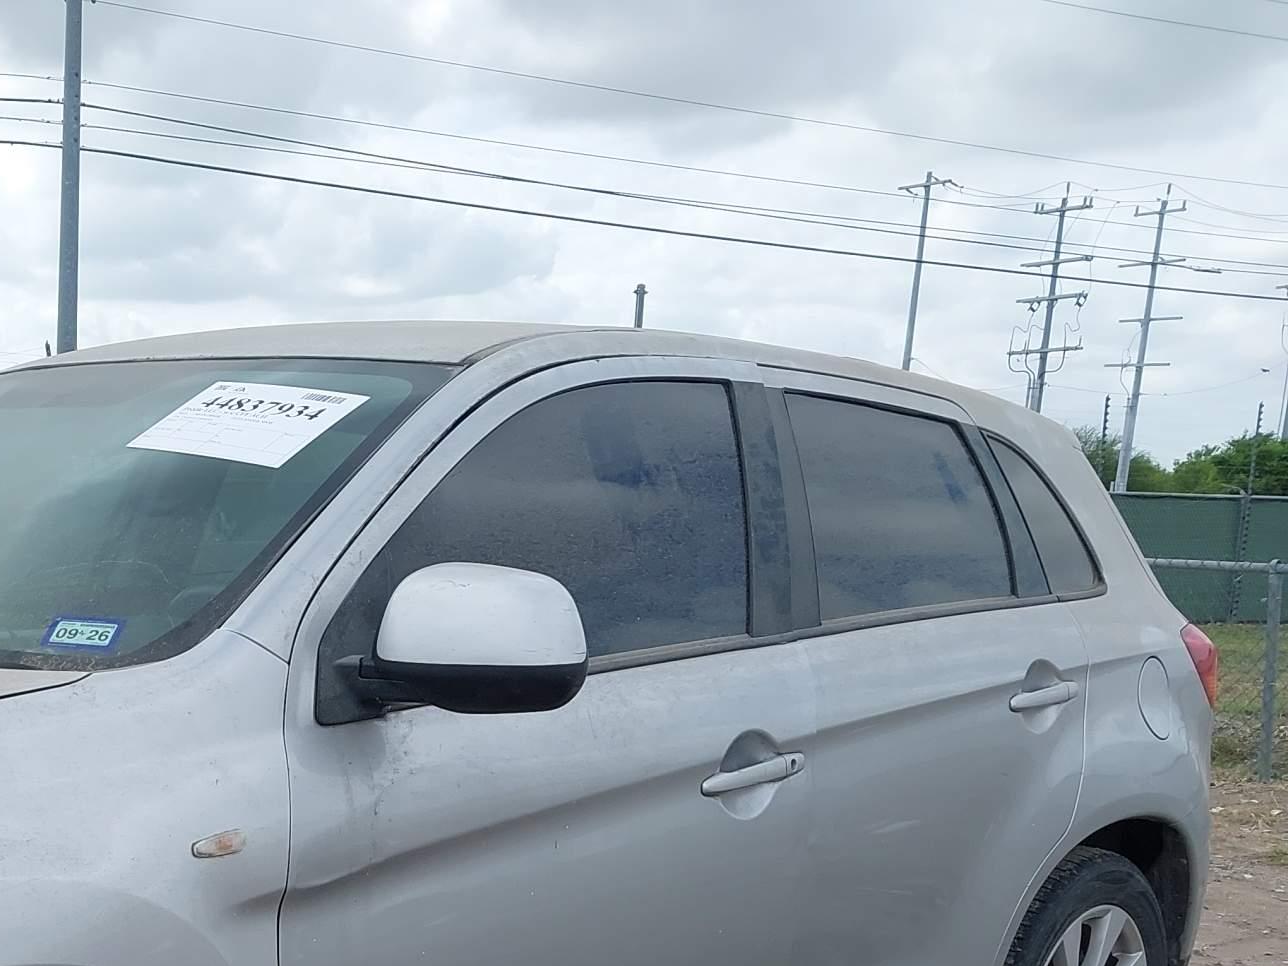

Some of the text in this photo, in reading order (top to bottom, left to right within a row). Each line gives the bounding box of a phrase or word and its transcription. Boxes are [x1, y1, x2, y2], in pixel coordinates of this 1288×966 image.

[202, 396, 326, 420] 44837934
[55, 627, 110, 641] 09 26
